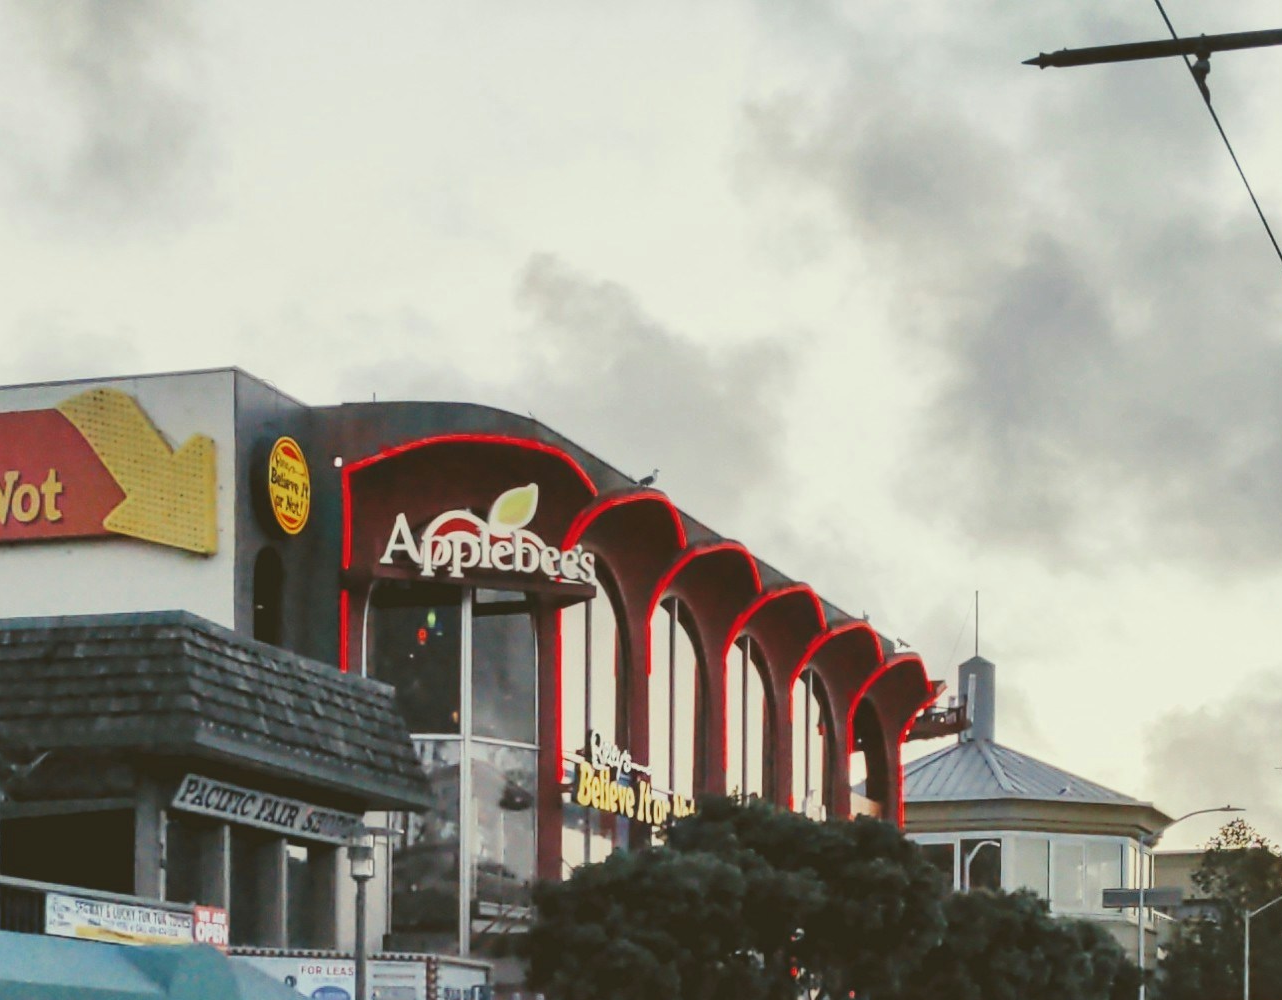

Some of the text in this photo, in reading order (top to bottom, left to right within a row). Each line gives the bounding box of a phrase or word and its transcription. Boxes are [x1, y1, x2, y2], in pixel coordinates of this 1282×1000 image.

[380, 511, 597, 584] Applebee's
[180, 778, 258, 817] PACIFIC
[255, 796, 300, 829] FAIR
[577, 761, 636, 819] Believe
[637, 780, 653, 825] It
[195, 921, 229, 946] OPEN
[301, 965, 355, 976] FOR LEAS
